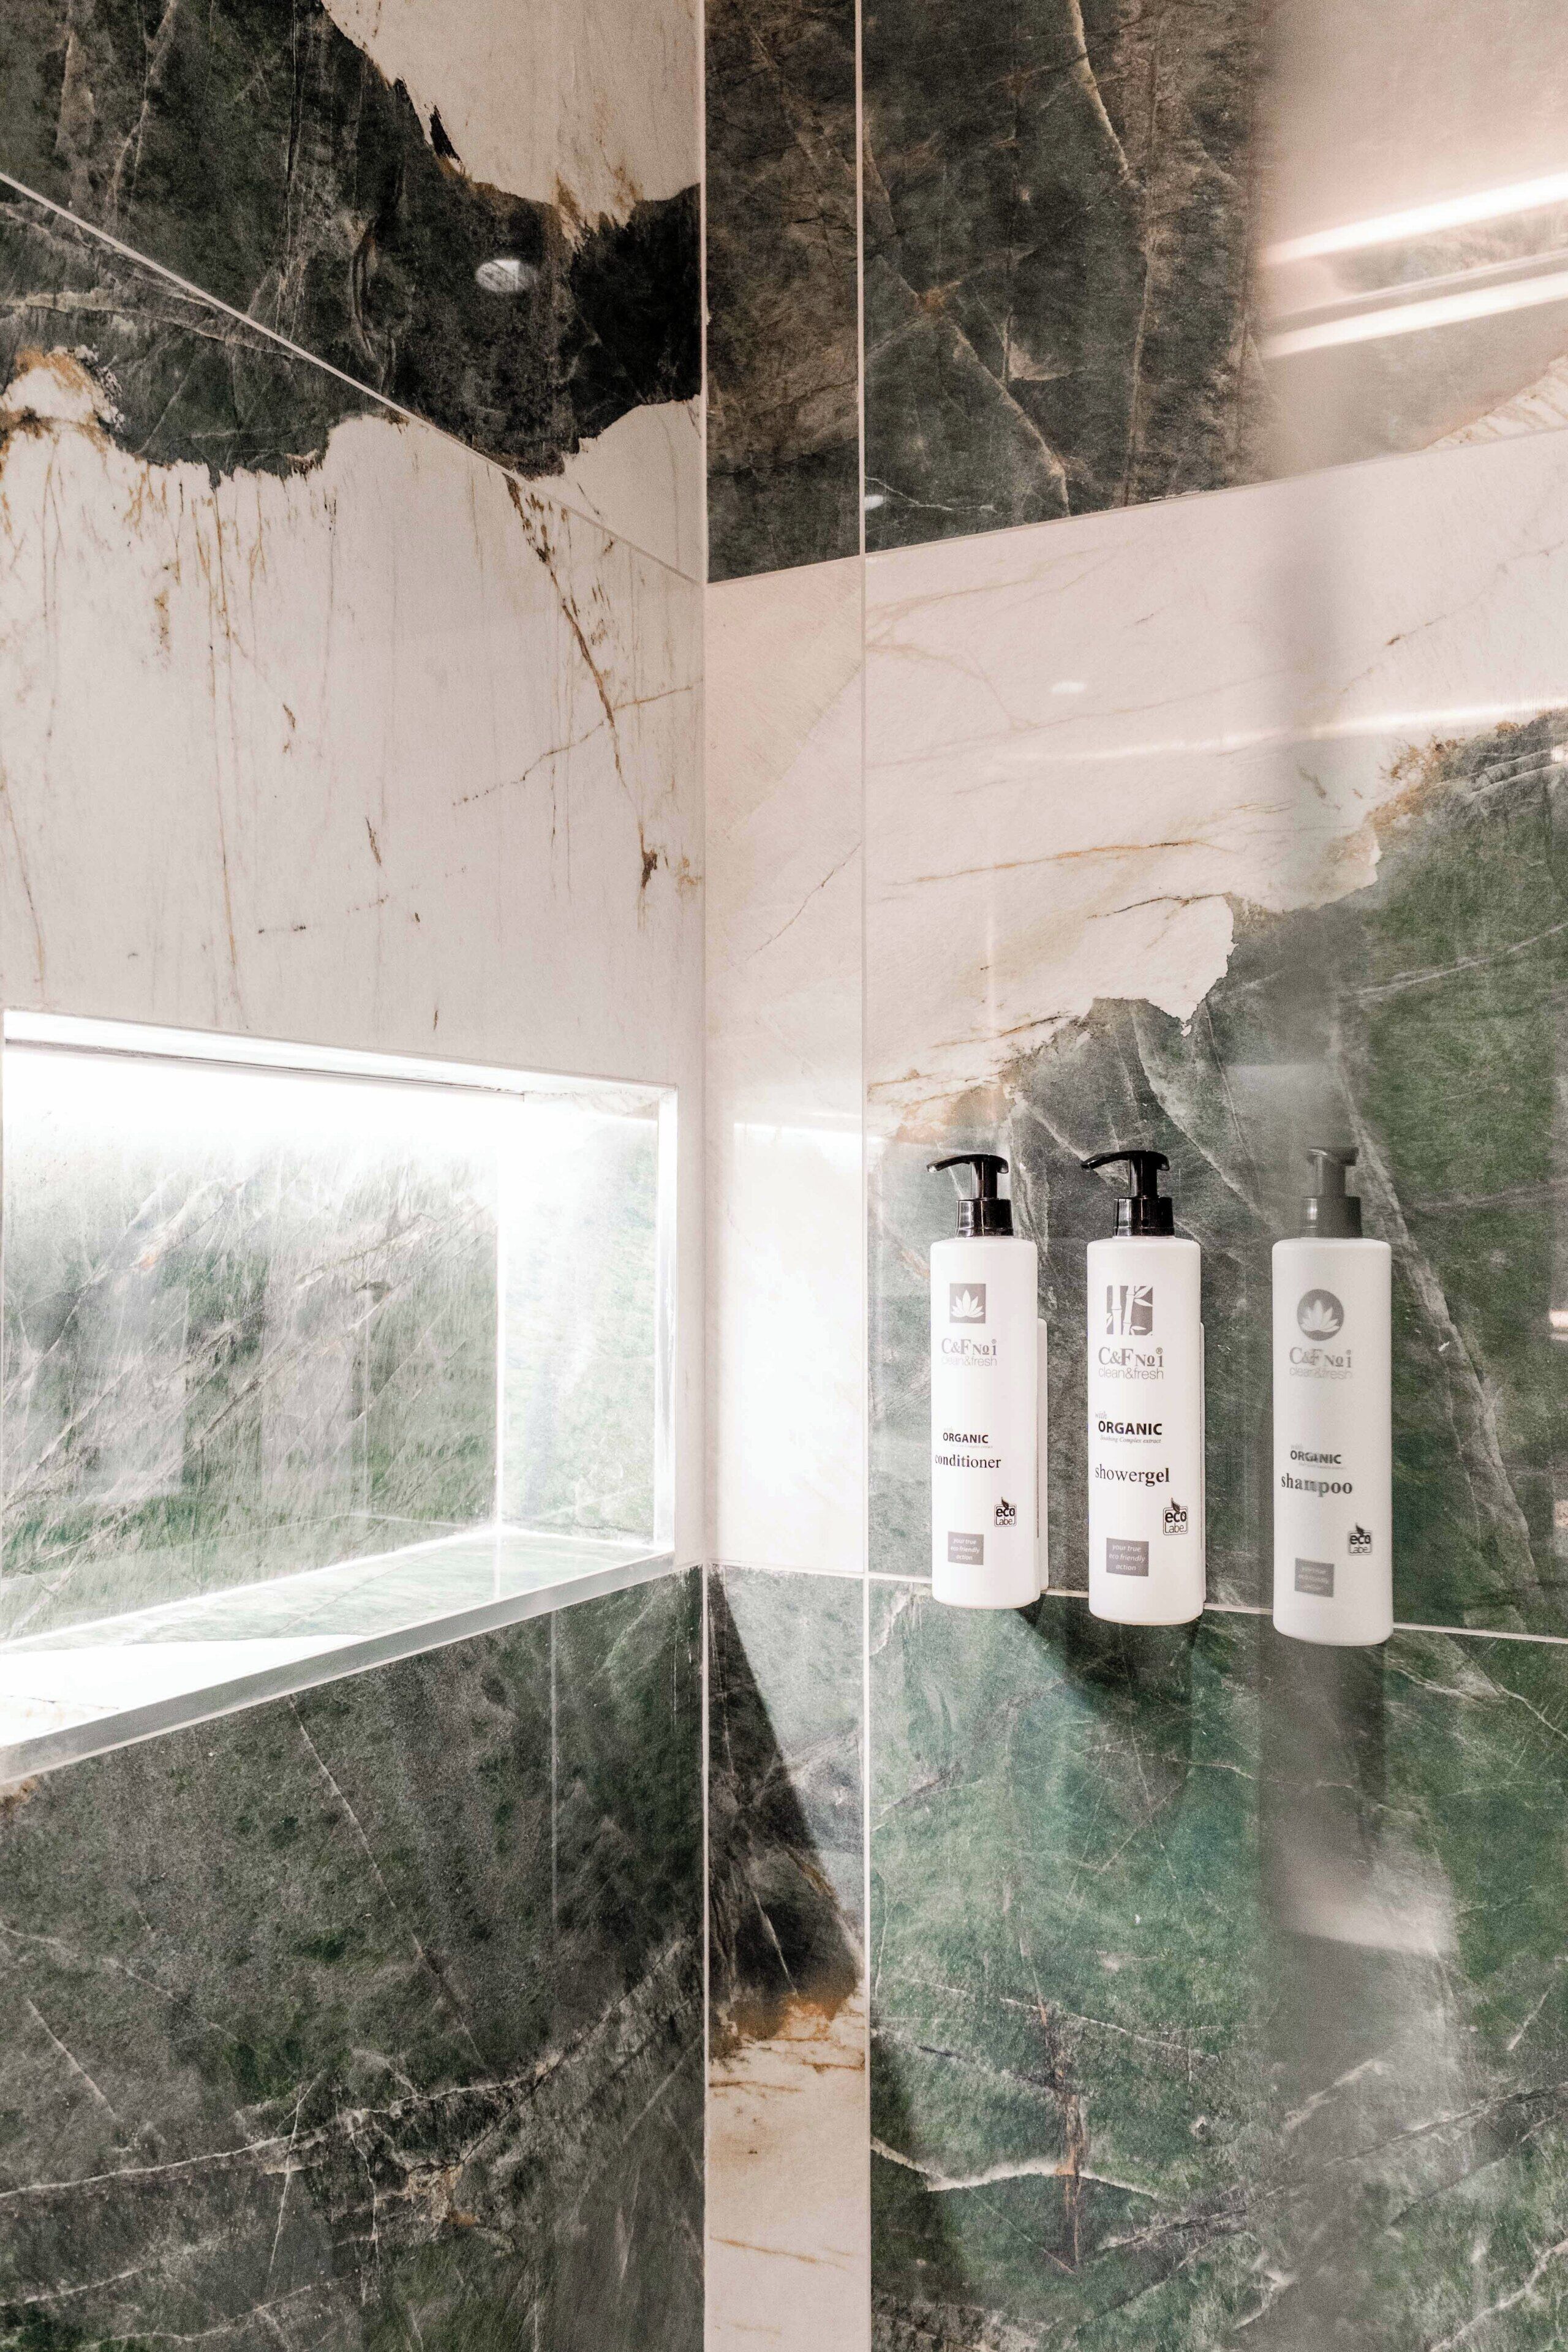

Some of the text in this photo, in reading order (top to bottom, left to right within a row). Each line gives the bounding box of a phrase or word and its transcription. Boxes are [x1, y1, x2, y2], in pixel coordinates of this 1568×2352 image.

[941, 1338, 971, 1355] C&F
[941, 1355, 997, 1366] cean&fresh
[1098, 1346, 1134, 1366] C&F
[1098, 1366, 1164, 1380] clean&fresh
[1095, 1411, 1107, 1420] with
[1098, 1420, 1163, 1436] ORGANIC
[943, 1432, 989, 1444] ORGANIC
[935, 1454, 1001, 1468] conditioner
[1290, 1450, 1342, 1464] ORGANIC
[1095, 1463, 1170, 1487] showergel
[1281, 1472, 1354, 1498] shampoo
[995, 1507, 1016, 1517] eco
[1164, 1511, 1187, 1523] eco
[1349, 1534, 1371, 1545] eco
[1120, 1553, 1146, 1563] friendly
